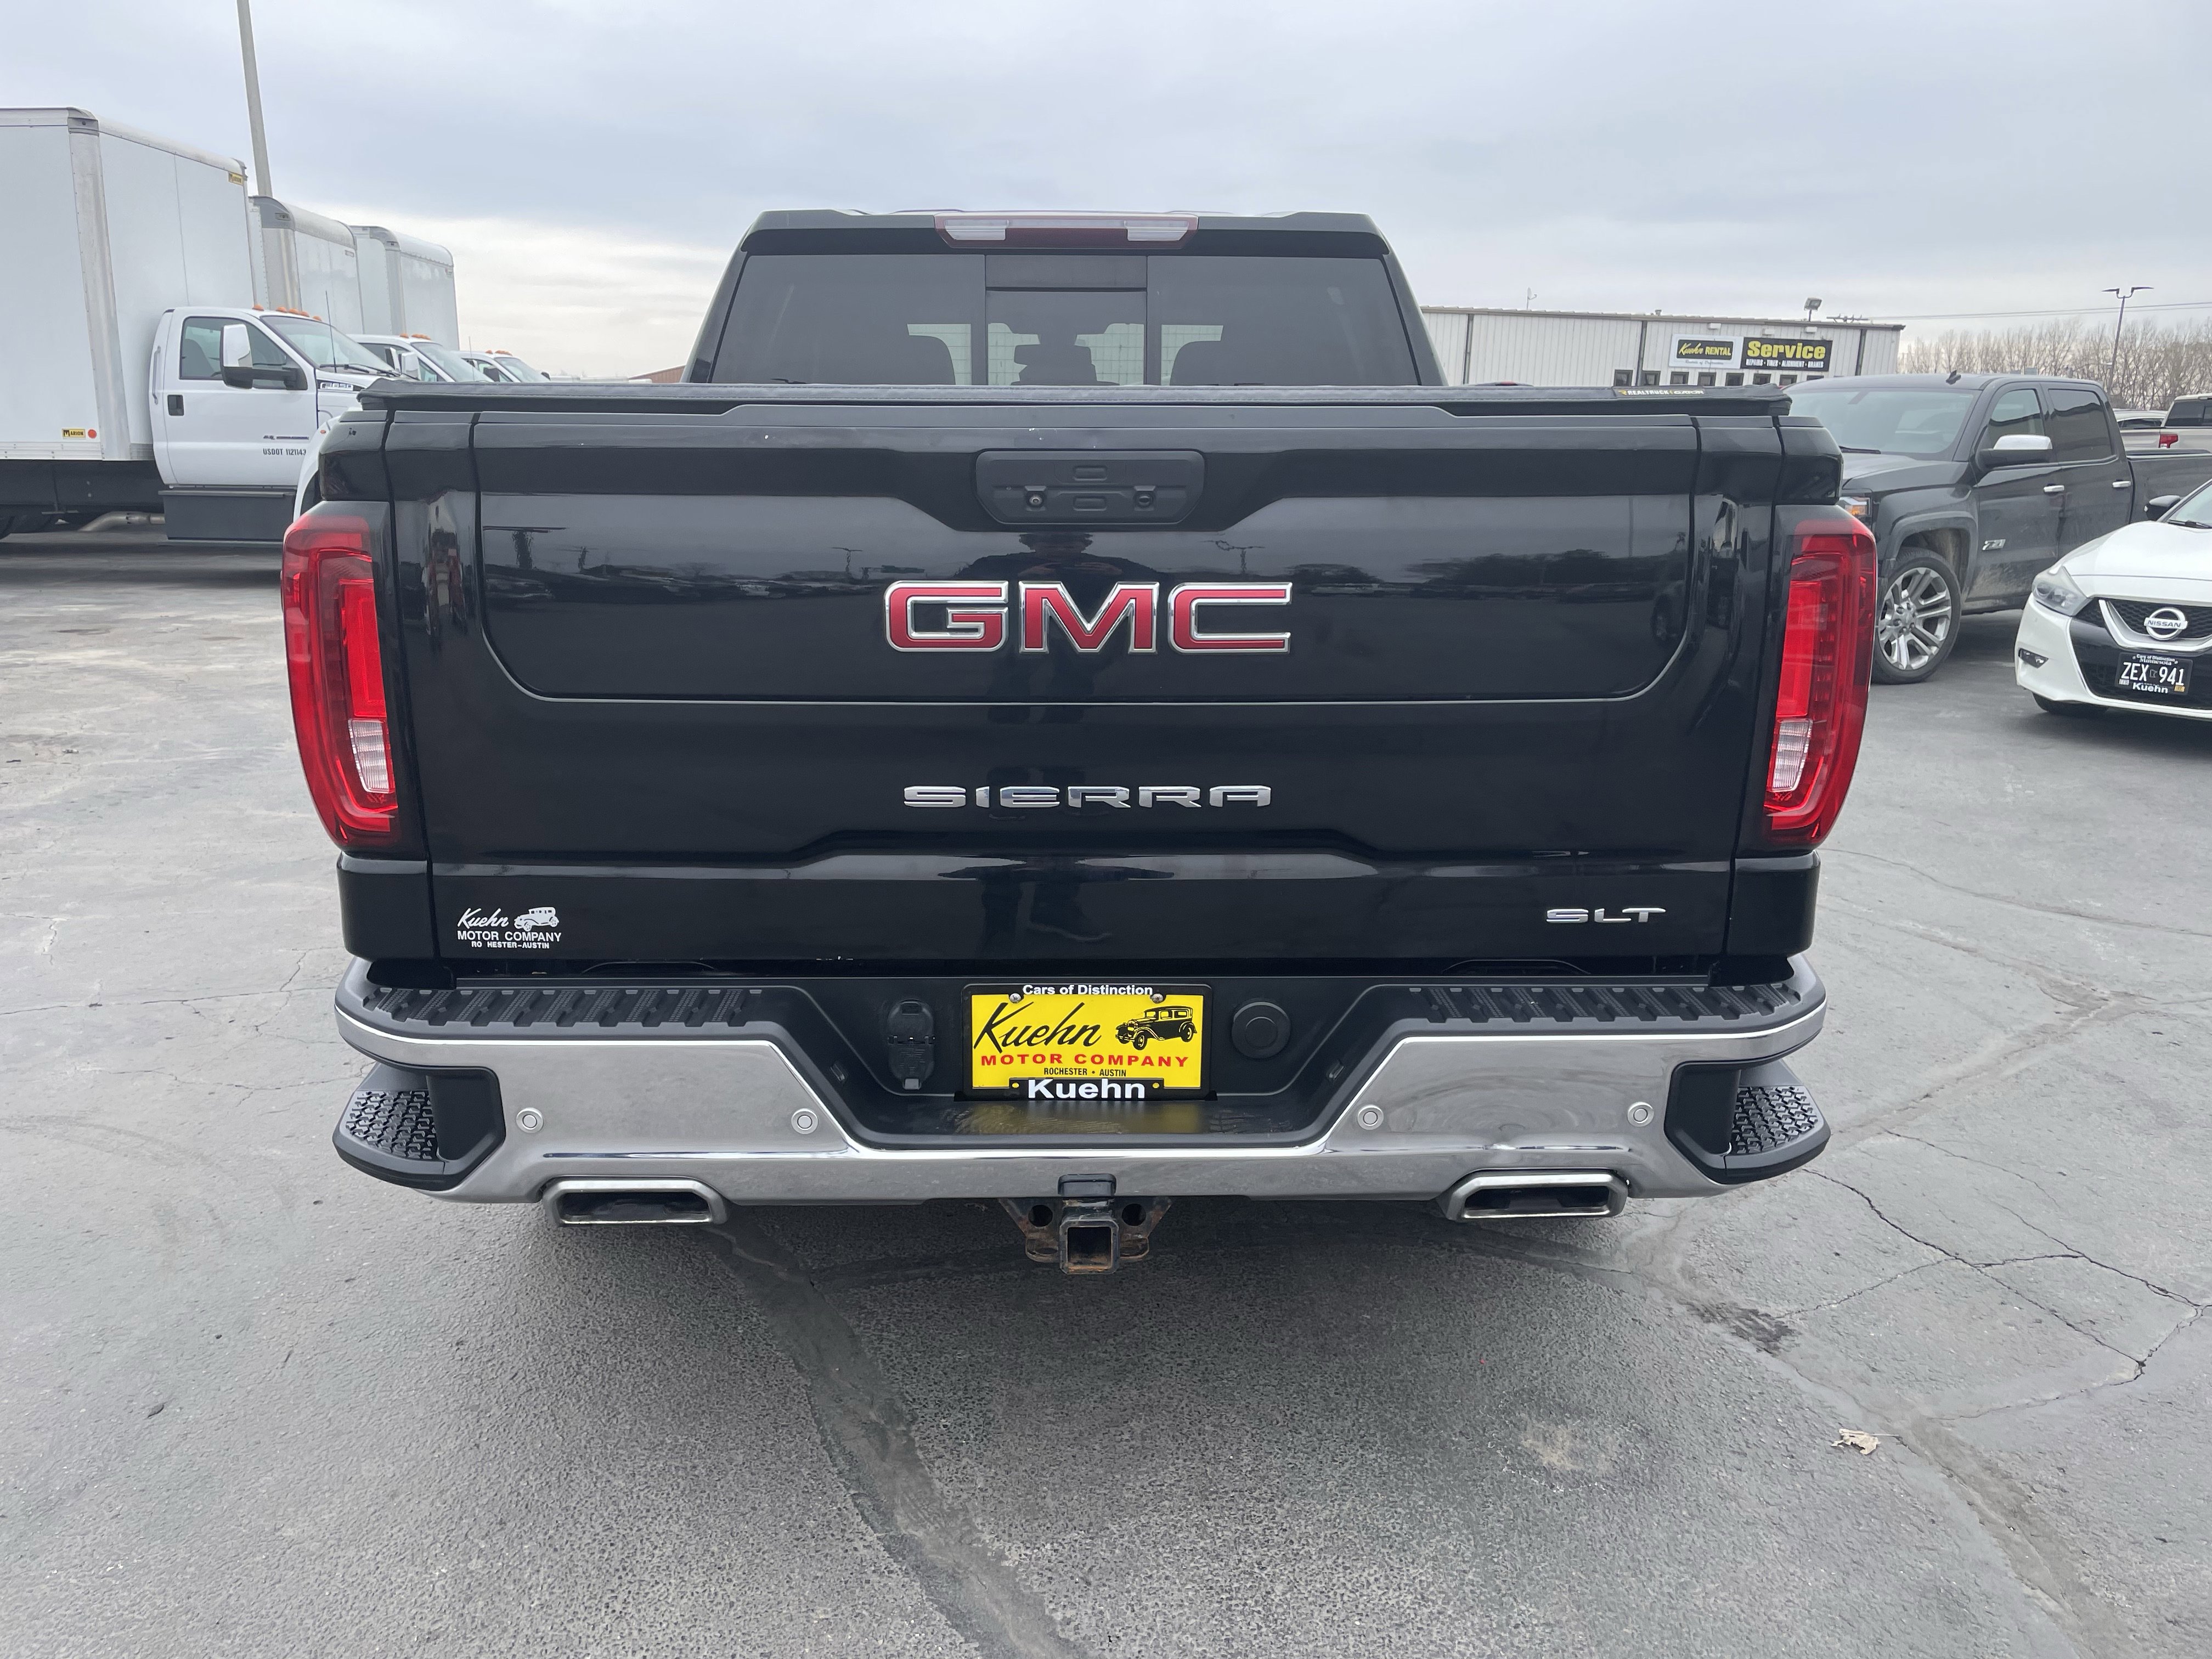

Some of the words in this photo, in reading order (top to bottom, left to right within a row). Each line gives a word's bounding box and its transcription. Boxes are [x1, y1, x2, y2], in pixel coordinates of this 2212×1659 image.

[1679, 342, 1703, 356] Kuehn
[1705, 346, 1731, 356] RENTAL
[1747, 340, 1826, 359] Service
[884, 580, 1294, 654] GMC
[2139, 657, 2172, 665] Minnesota
[2121, 662, 2149, 681] ZEX
[2159, 666, 2184, 686] 941
[2132, 682, 2168, 693] Kuehn
[903, 785, 1272, 809] SIERRA
[457, 908, 509, 929] Kuehn
[1546, 907, 1666, 923] SLT
[457, 930, 499, 941] MOTOR
[505, 932, 562, 942] COMPANY
[1023, 984, 1056, 995] Cars
[1060, 984, 1075, 995] of
[1078, 985, 1153, 995] Distinction
[974, 1002, 1102, 1053] Kuehn
[981, 1054, 1062, 1066] MOTOR
[1074, 1054, 1189, 1067] COMPANY
[1043, 1068, 1087, 1076] ROCHESTER
[1099, 1068, 1126, 1077] AUSTIN
[1028, 1079, 1146, 1099] Kuehn
